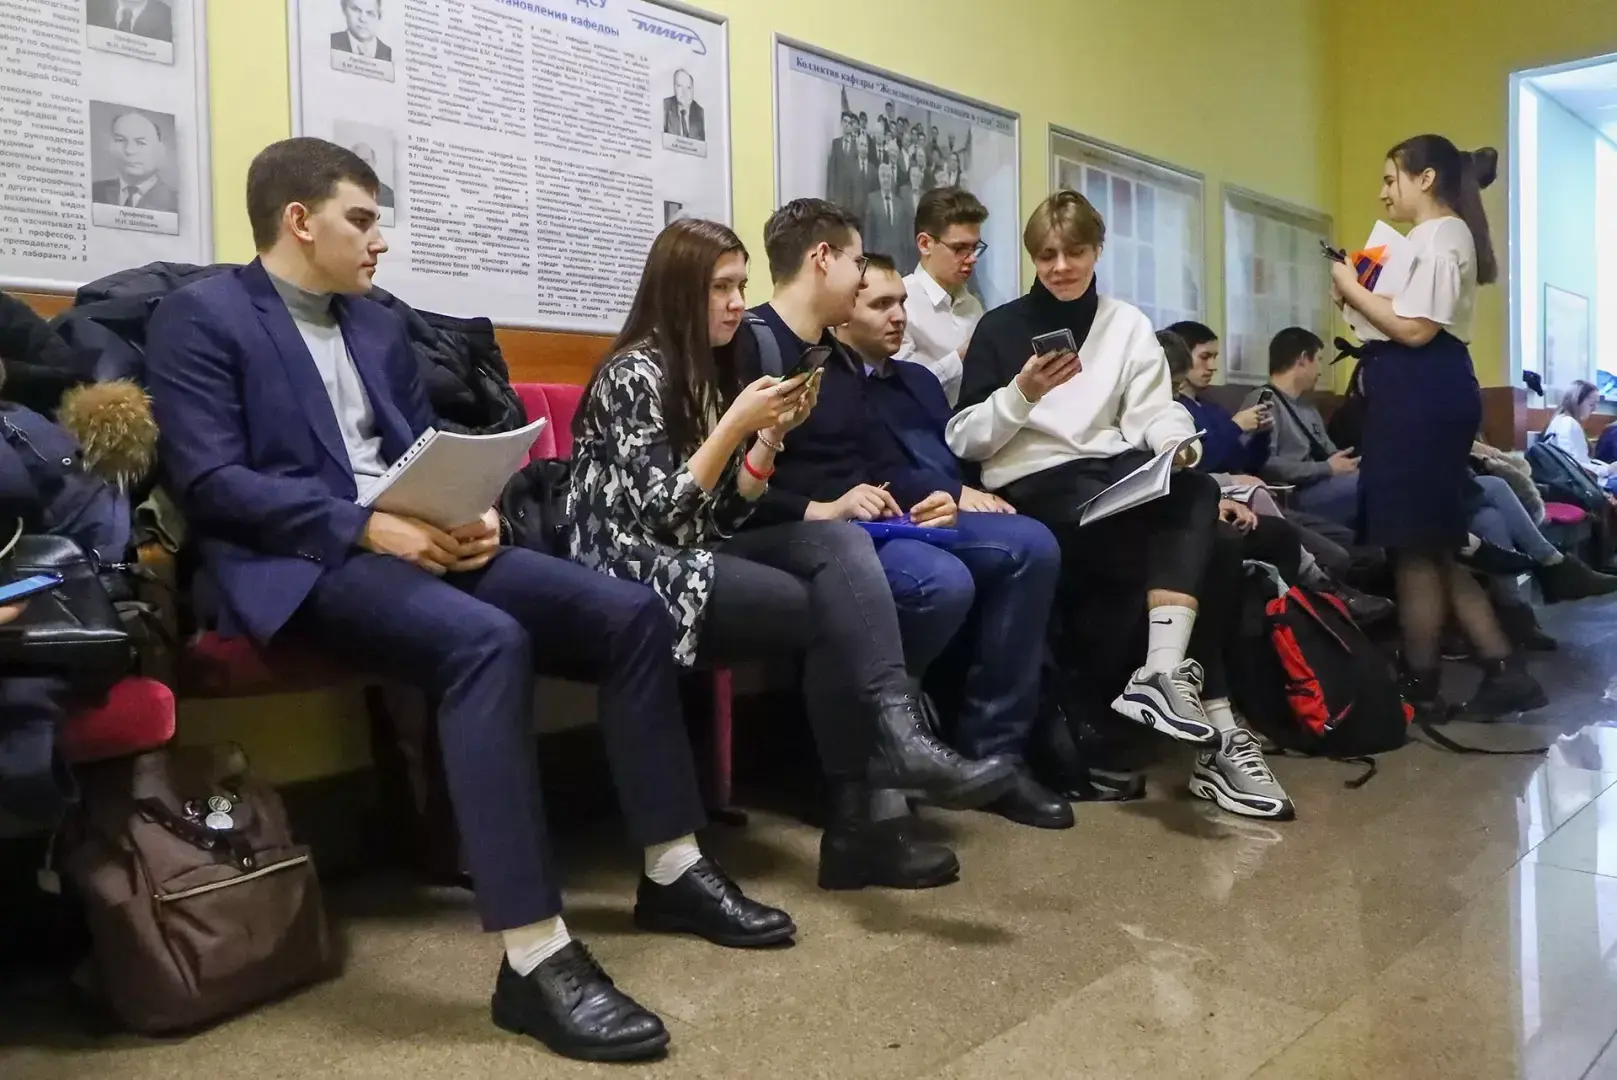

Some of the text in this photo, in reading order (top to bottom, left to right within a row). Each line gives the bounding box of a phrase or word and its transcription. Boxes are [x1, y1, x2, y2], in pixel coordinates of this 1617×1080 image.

[495, 0, 620, 37] ановления кафедры
[6, 68, 49, 80] кафедрой
[37, 63, 82, 76] профессор
[796, 56, 840, 79] Коллектив
[841, 73, 875, 89] кафедры
[14, 109, 84, 124] кафедрой был
[24, 133, 84, 145] руководством
[46, 157, 84, 167] вопросов
[4, 216, 18, 224] год
[29, 230, 76, 240] профессор,
[4, 238, 70, 250] преподавателя,
[22, 250, 66, 260] лаборанта
